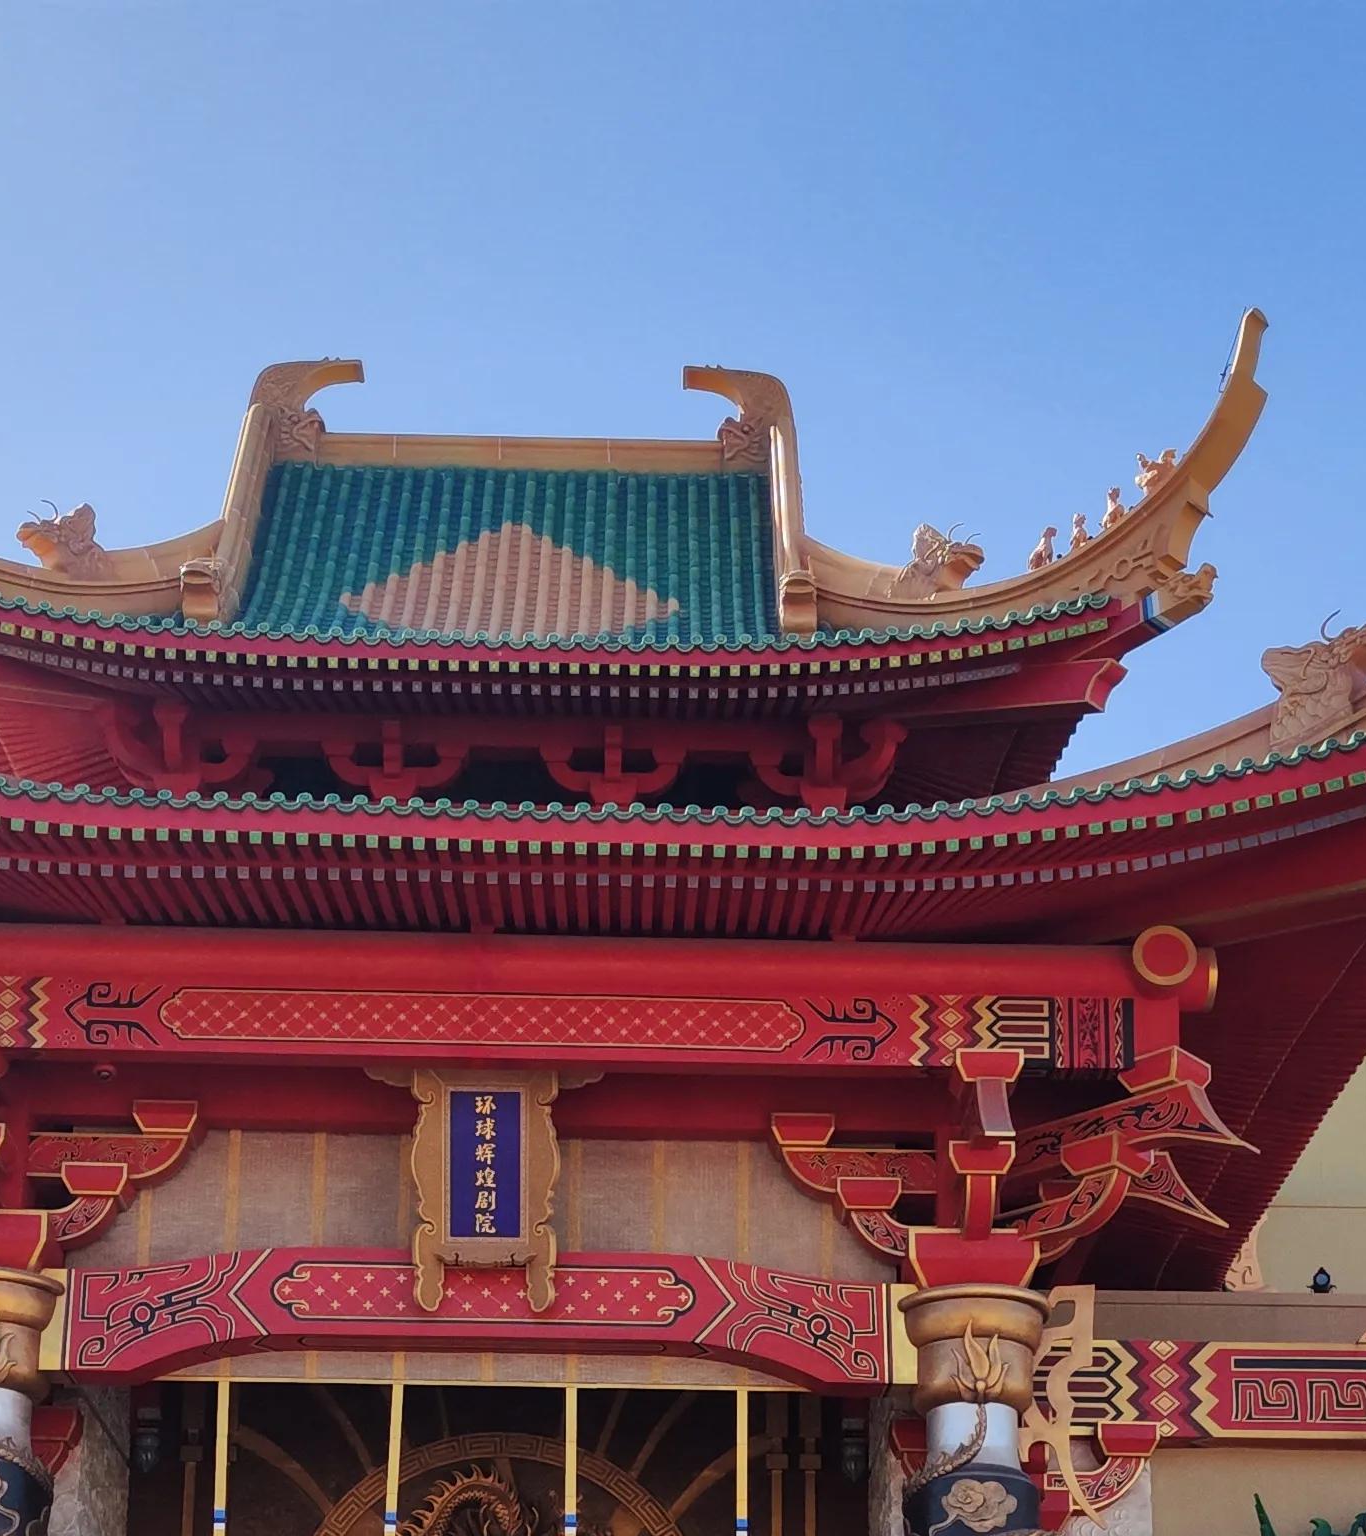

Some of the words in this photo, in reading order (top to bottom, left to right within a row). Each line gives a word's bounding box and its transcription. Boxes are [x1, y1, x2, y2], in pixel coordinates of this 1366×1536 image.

[474, 1095, 497, 1234] 环球辉煌剧院
